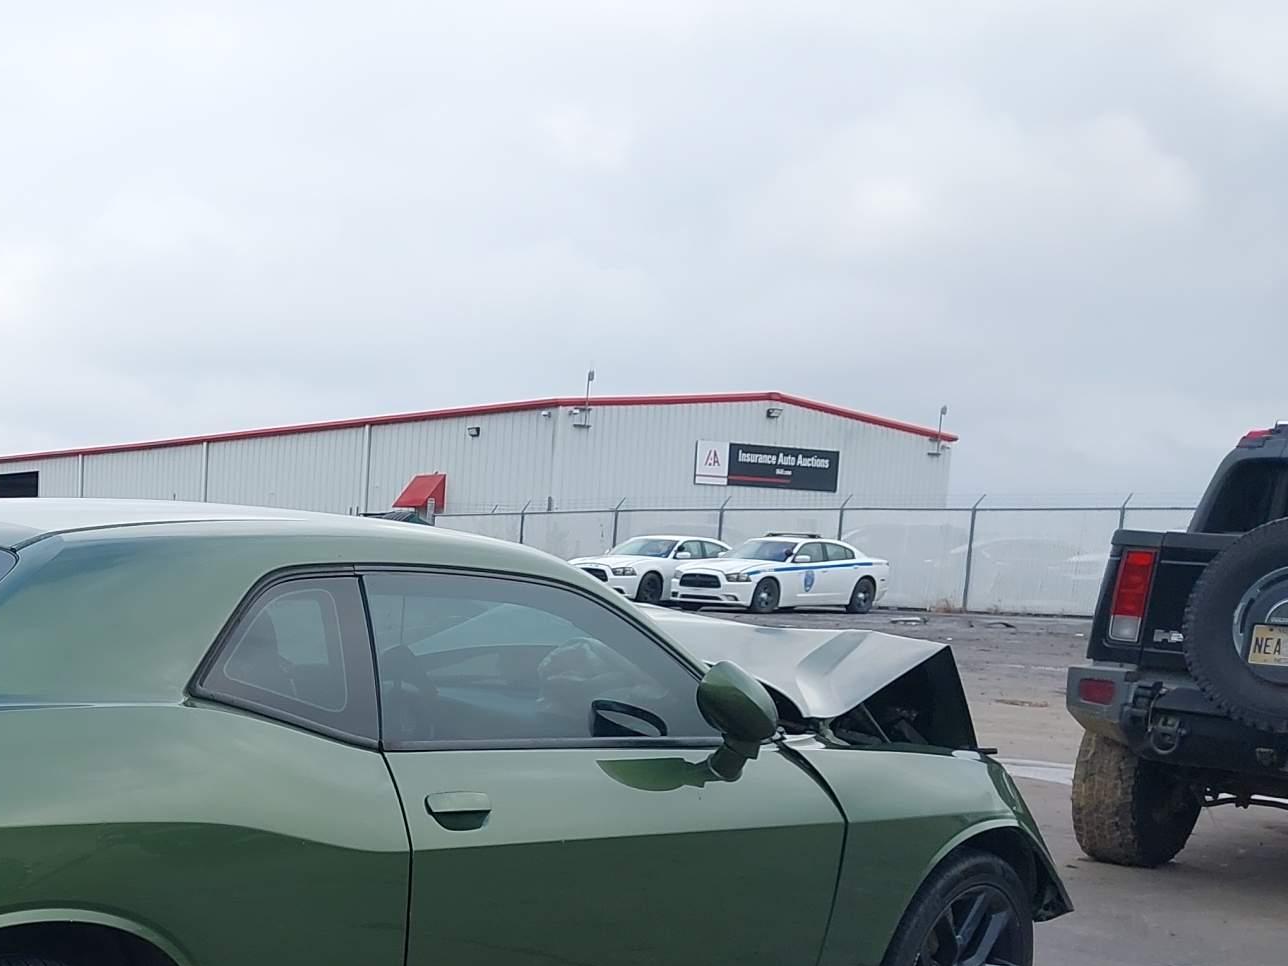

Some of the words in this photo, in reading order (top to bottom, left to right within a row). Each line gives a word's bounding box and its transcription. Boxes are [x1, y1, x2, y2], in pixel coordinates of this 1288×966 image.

[738, 449, 777, 465] Insurance
[777, 452, 796, 466] Auto
[796, 454, 830, 469] Auctions
[1253, 636, 1281, 655] NEA
